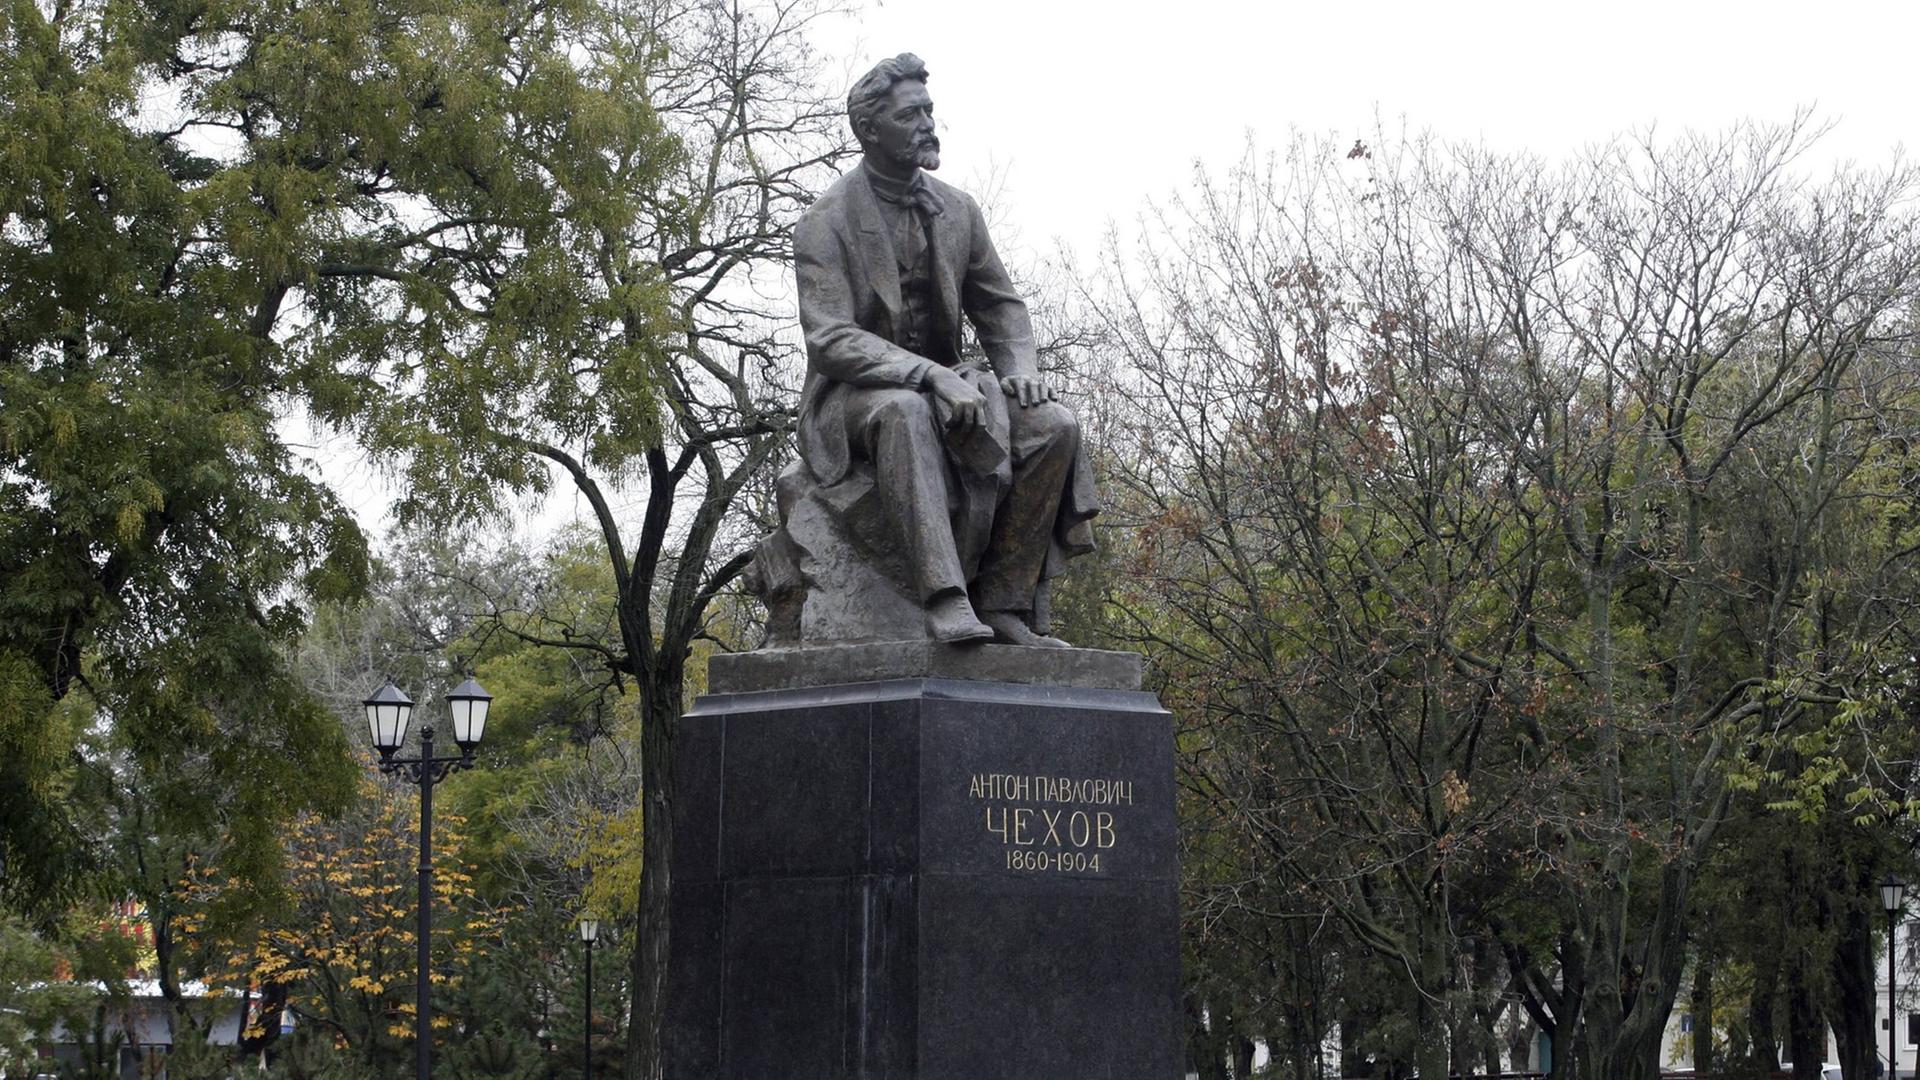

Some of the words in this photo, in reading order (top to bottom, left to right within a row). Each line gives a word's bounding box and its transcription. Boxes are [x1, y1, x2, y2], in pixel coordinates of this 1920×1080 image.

[969, 774, 1028, 800] АНТОН
[1035, 777, 1133, 805] ПАВЛОВИЧ
[987, 807, 1115, 848] ЧЕХОВ
[1007, 850, 1099, 872] 1860-1904
